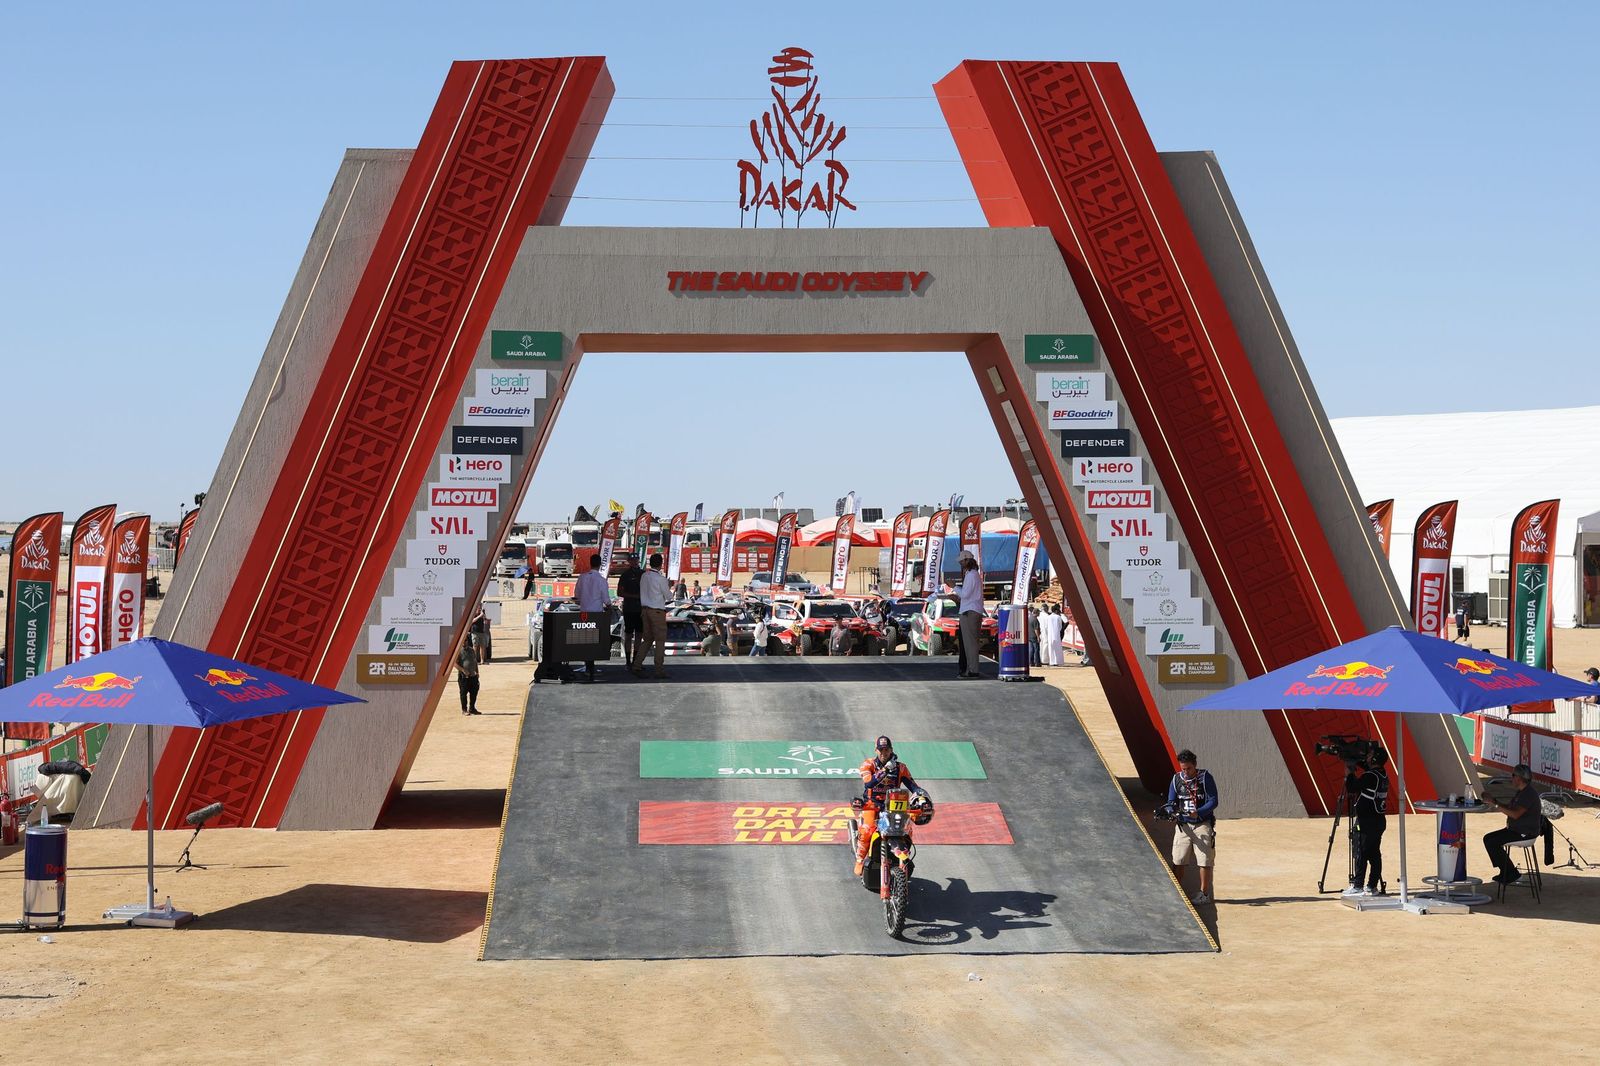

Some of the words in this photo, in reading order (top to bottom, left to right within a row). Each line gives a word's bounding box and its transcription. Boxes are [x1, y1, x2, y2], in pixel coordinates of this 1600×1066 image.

[737, 160, 856, 212] DAKAR
[668, 272, 714, 292] THE
[716, 272, 800, 292] SAUDI
[801, 272, 929, 292] ODYSSEY
[491, 373, 530, 386] berain
[1052, 377, 1088, 389] berain
[468, 406, 530, 415] BFGoodrich
[457, 436, 518, 444] DEFENDER
[466, 460, 502, 471] Hero
[1098, 463, 1133, 473] Hero
[434, 491, 493, 504] MOTUL
[1091, 493, 1148, 506] MOTUL
[431, 517, 473, 534] SAL
[1111, 519, 1152, 536] SAL
[80, 543, 106, 557] DAKAR
[1422, 537, 1448, 550] DAKAR
[1520, 540, 1548, 554] DAKAR
[21, 556, 51, 571] DAKAR
[117, 553, 142, 565] DAKAR
[600, 547, 610, 571] TUDOR
[776, 539, 787, 582] DEFENDER
[838, 546, 846, 570] Hero
[930, 548, 938, 579] TUDOR
[1422, 577, 1440, 637] OTUL
[118, 589, 134, 642] Hero
[1527, 600, 1536, 642] ARABIA
[26, 619, 37, 663] ARABIA
[216, 686, 254, 703] Red
[252, 682, 289, 700] Bull
[1284, 681, 1333, 696] Red
[1335, 682, 1390, 696] Bull
[28, 693, 78, 708] Red
[82, 693, 136, 708] Bull
[732, 807, 858, 817] DREA
[1183, 800, 1195, 812] 15
[734, 819, 848, 829] DARE
[734, 831, 838, 842] LIVE
